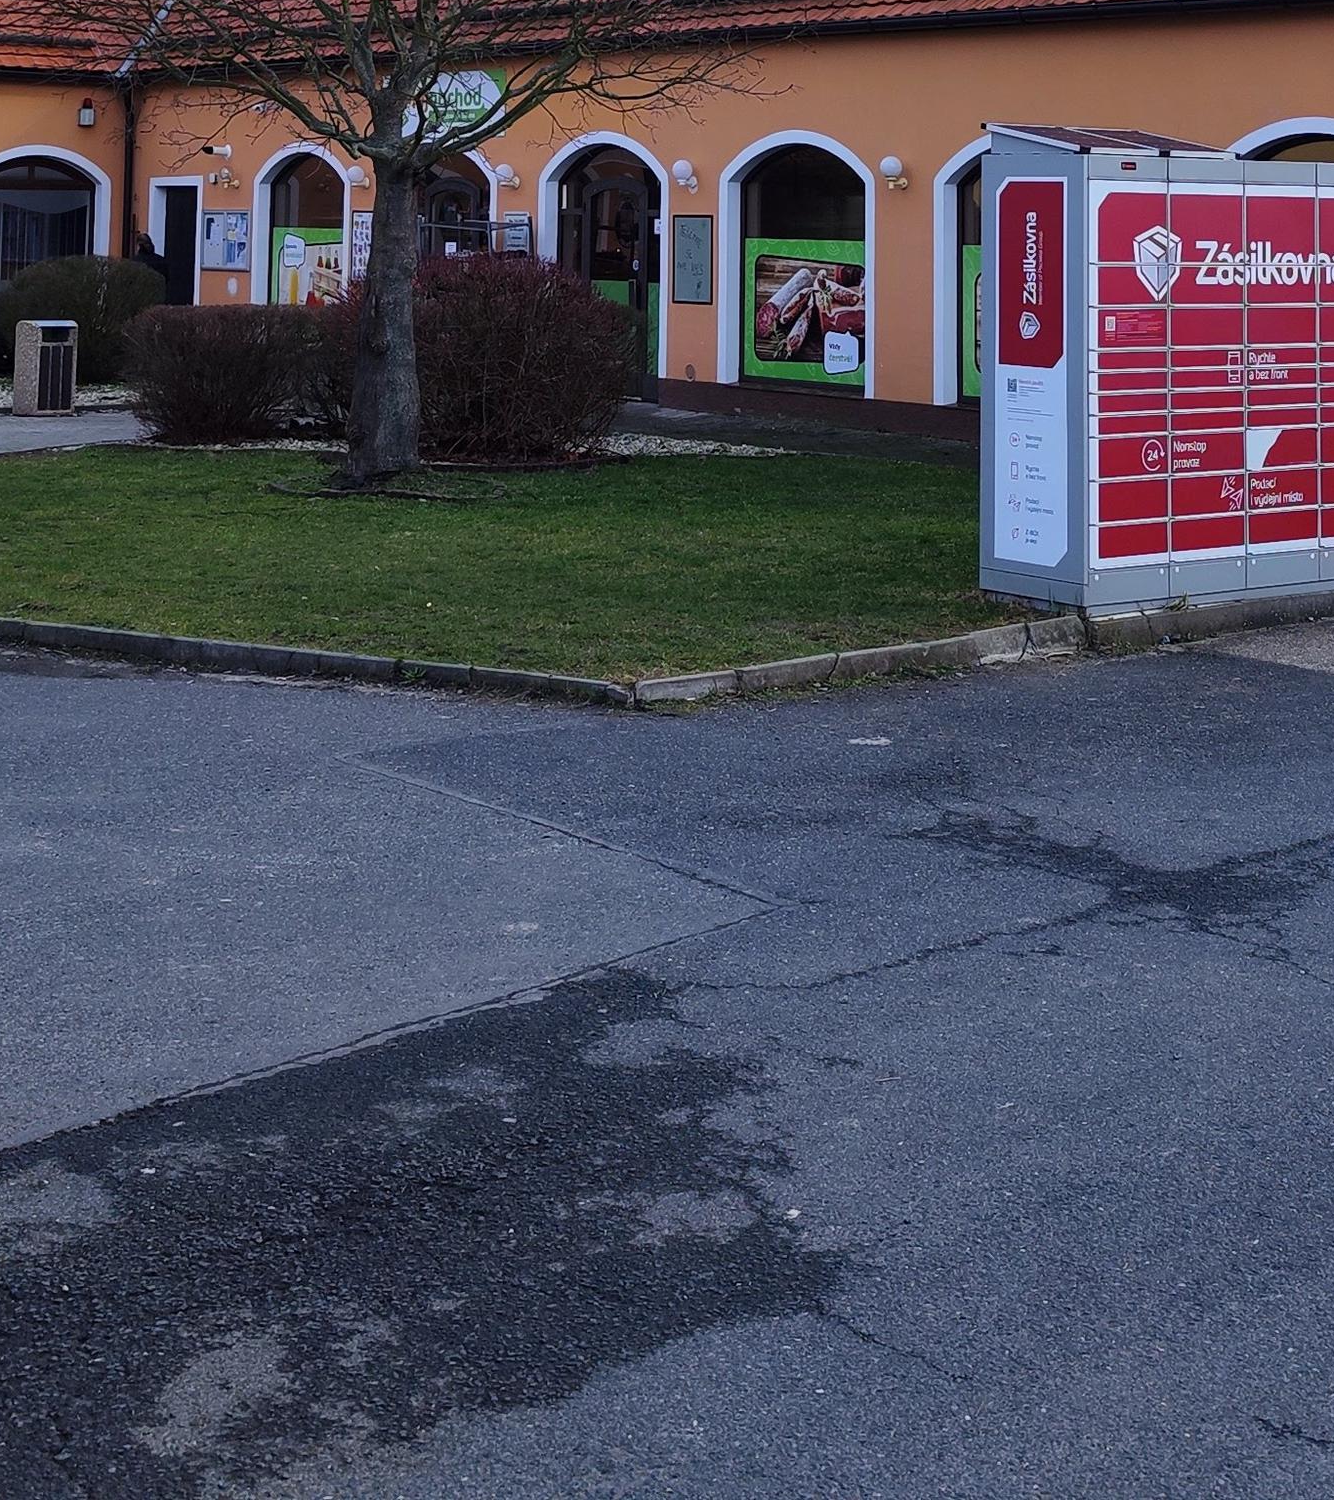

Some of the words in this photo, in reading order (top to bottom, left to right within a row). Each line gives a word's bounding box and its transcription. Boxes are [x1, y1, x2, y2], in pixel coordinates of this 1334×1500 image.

[1022, 211, 1037, 305] Zásilkovna
[1248, 352, 1276, 366] Rychle
[1248, 370, 1254, 380] a
[1255, 369, 1269, 380] bez
[1173, 440, 1207, 454] Nonstop
[1146, 449, 1159, 462] 24
[1173, 458, 1201, 471] provoz
[1250, 477, 1277, 490] Podací
[1254, 492, 1283, 508] výdejní
[1282, 491, 1304, 502] místo
